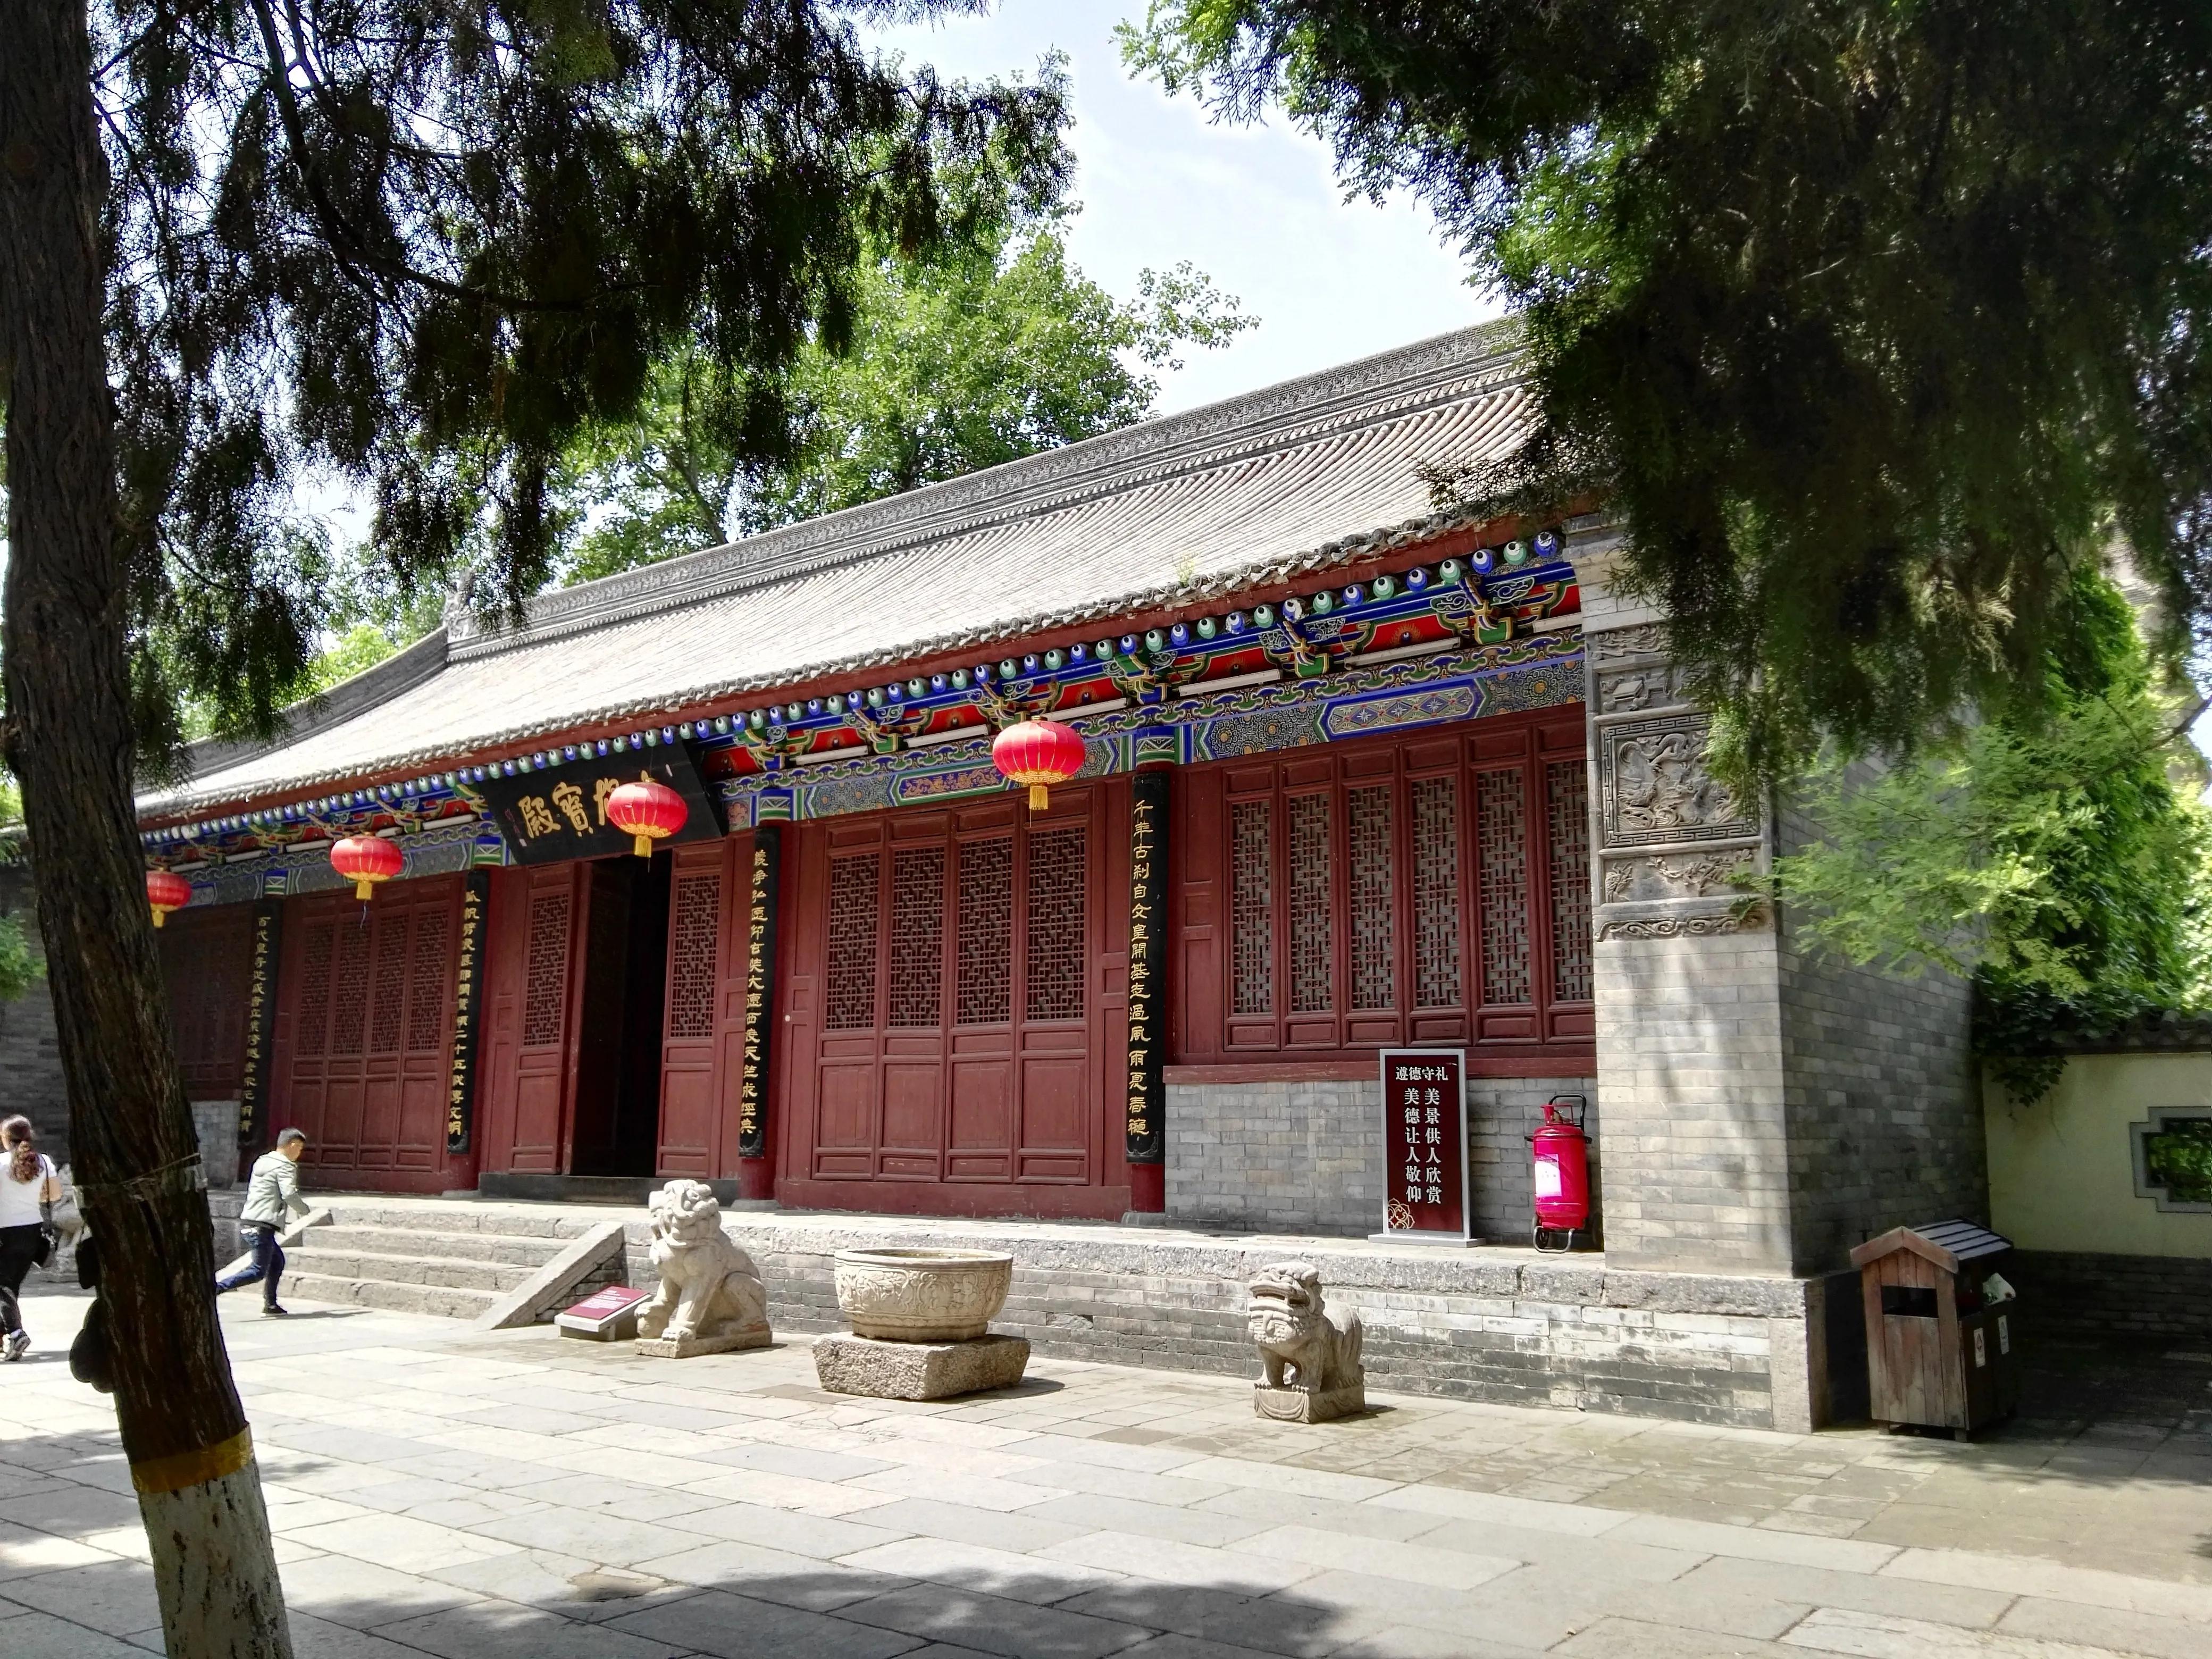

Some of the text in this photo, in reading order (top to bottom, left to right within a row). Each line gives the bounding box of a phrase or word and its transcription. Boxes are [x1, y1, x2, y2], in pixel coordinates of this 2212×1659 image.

[1395, 1066, 1449, 1081] 遵德守礼
[1404, 1087, 1422, 1203] 美德让人敬仰
[1425, 1088, 1443, 1204] 美景供人欣赏
